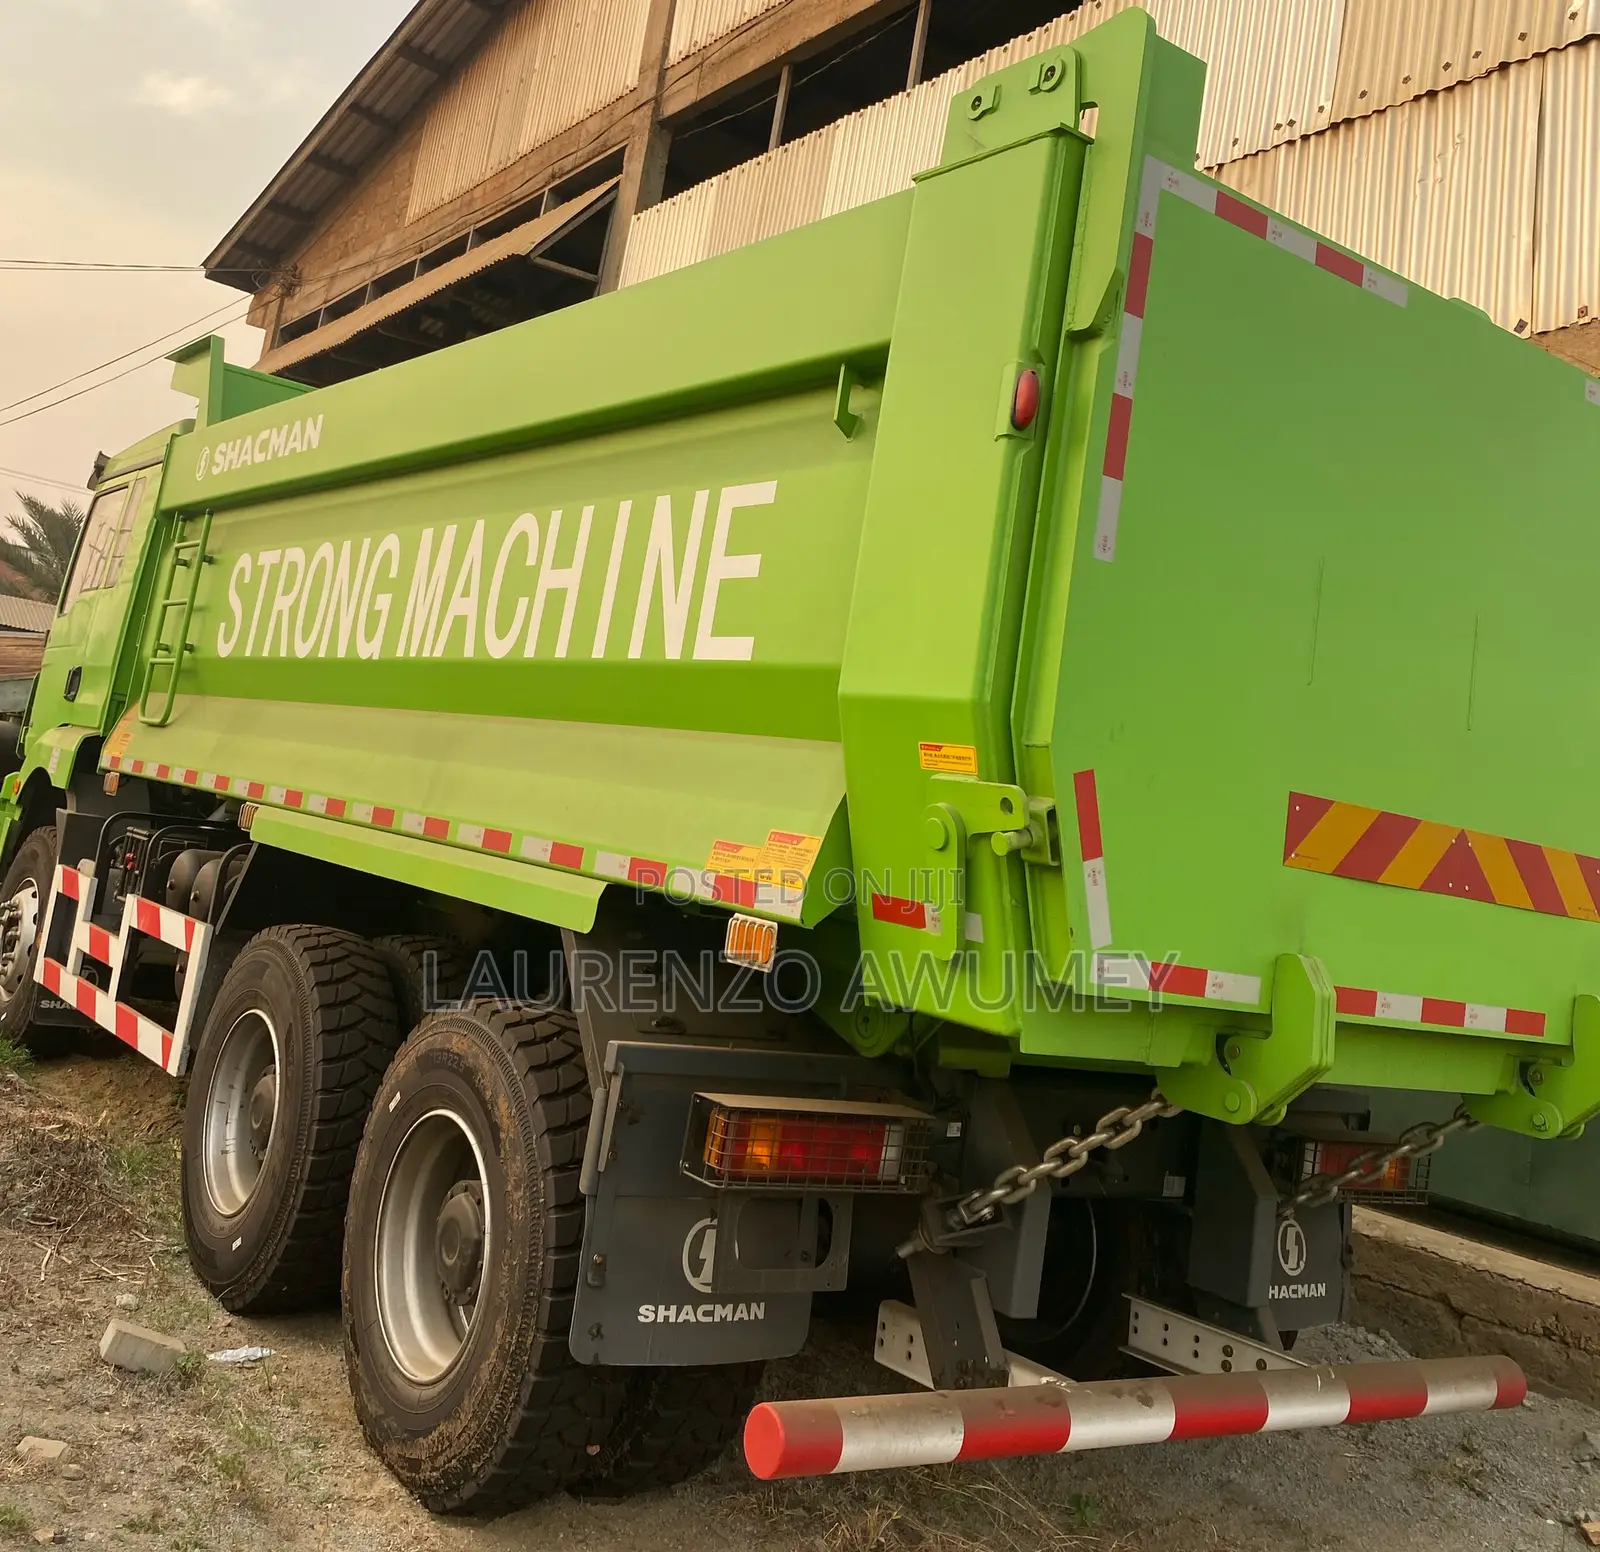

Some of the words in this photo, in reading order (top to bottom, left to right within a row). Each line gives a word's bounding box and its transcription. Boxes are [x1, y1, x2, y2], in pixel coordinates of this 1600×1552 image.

[211, 414, 323, 475] SHACMAN
[216, 534, 398, 659] STRONG
[400, 480, 777, 661] MACHINE
[40, 1000, 74, 1009] SHA
[1269, 1283, 1326, 1299] HACMAN
[637, 1301, 766, 1322] SHACMAN
